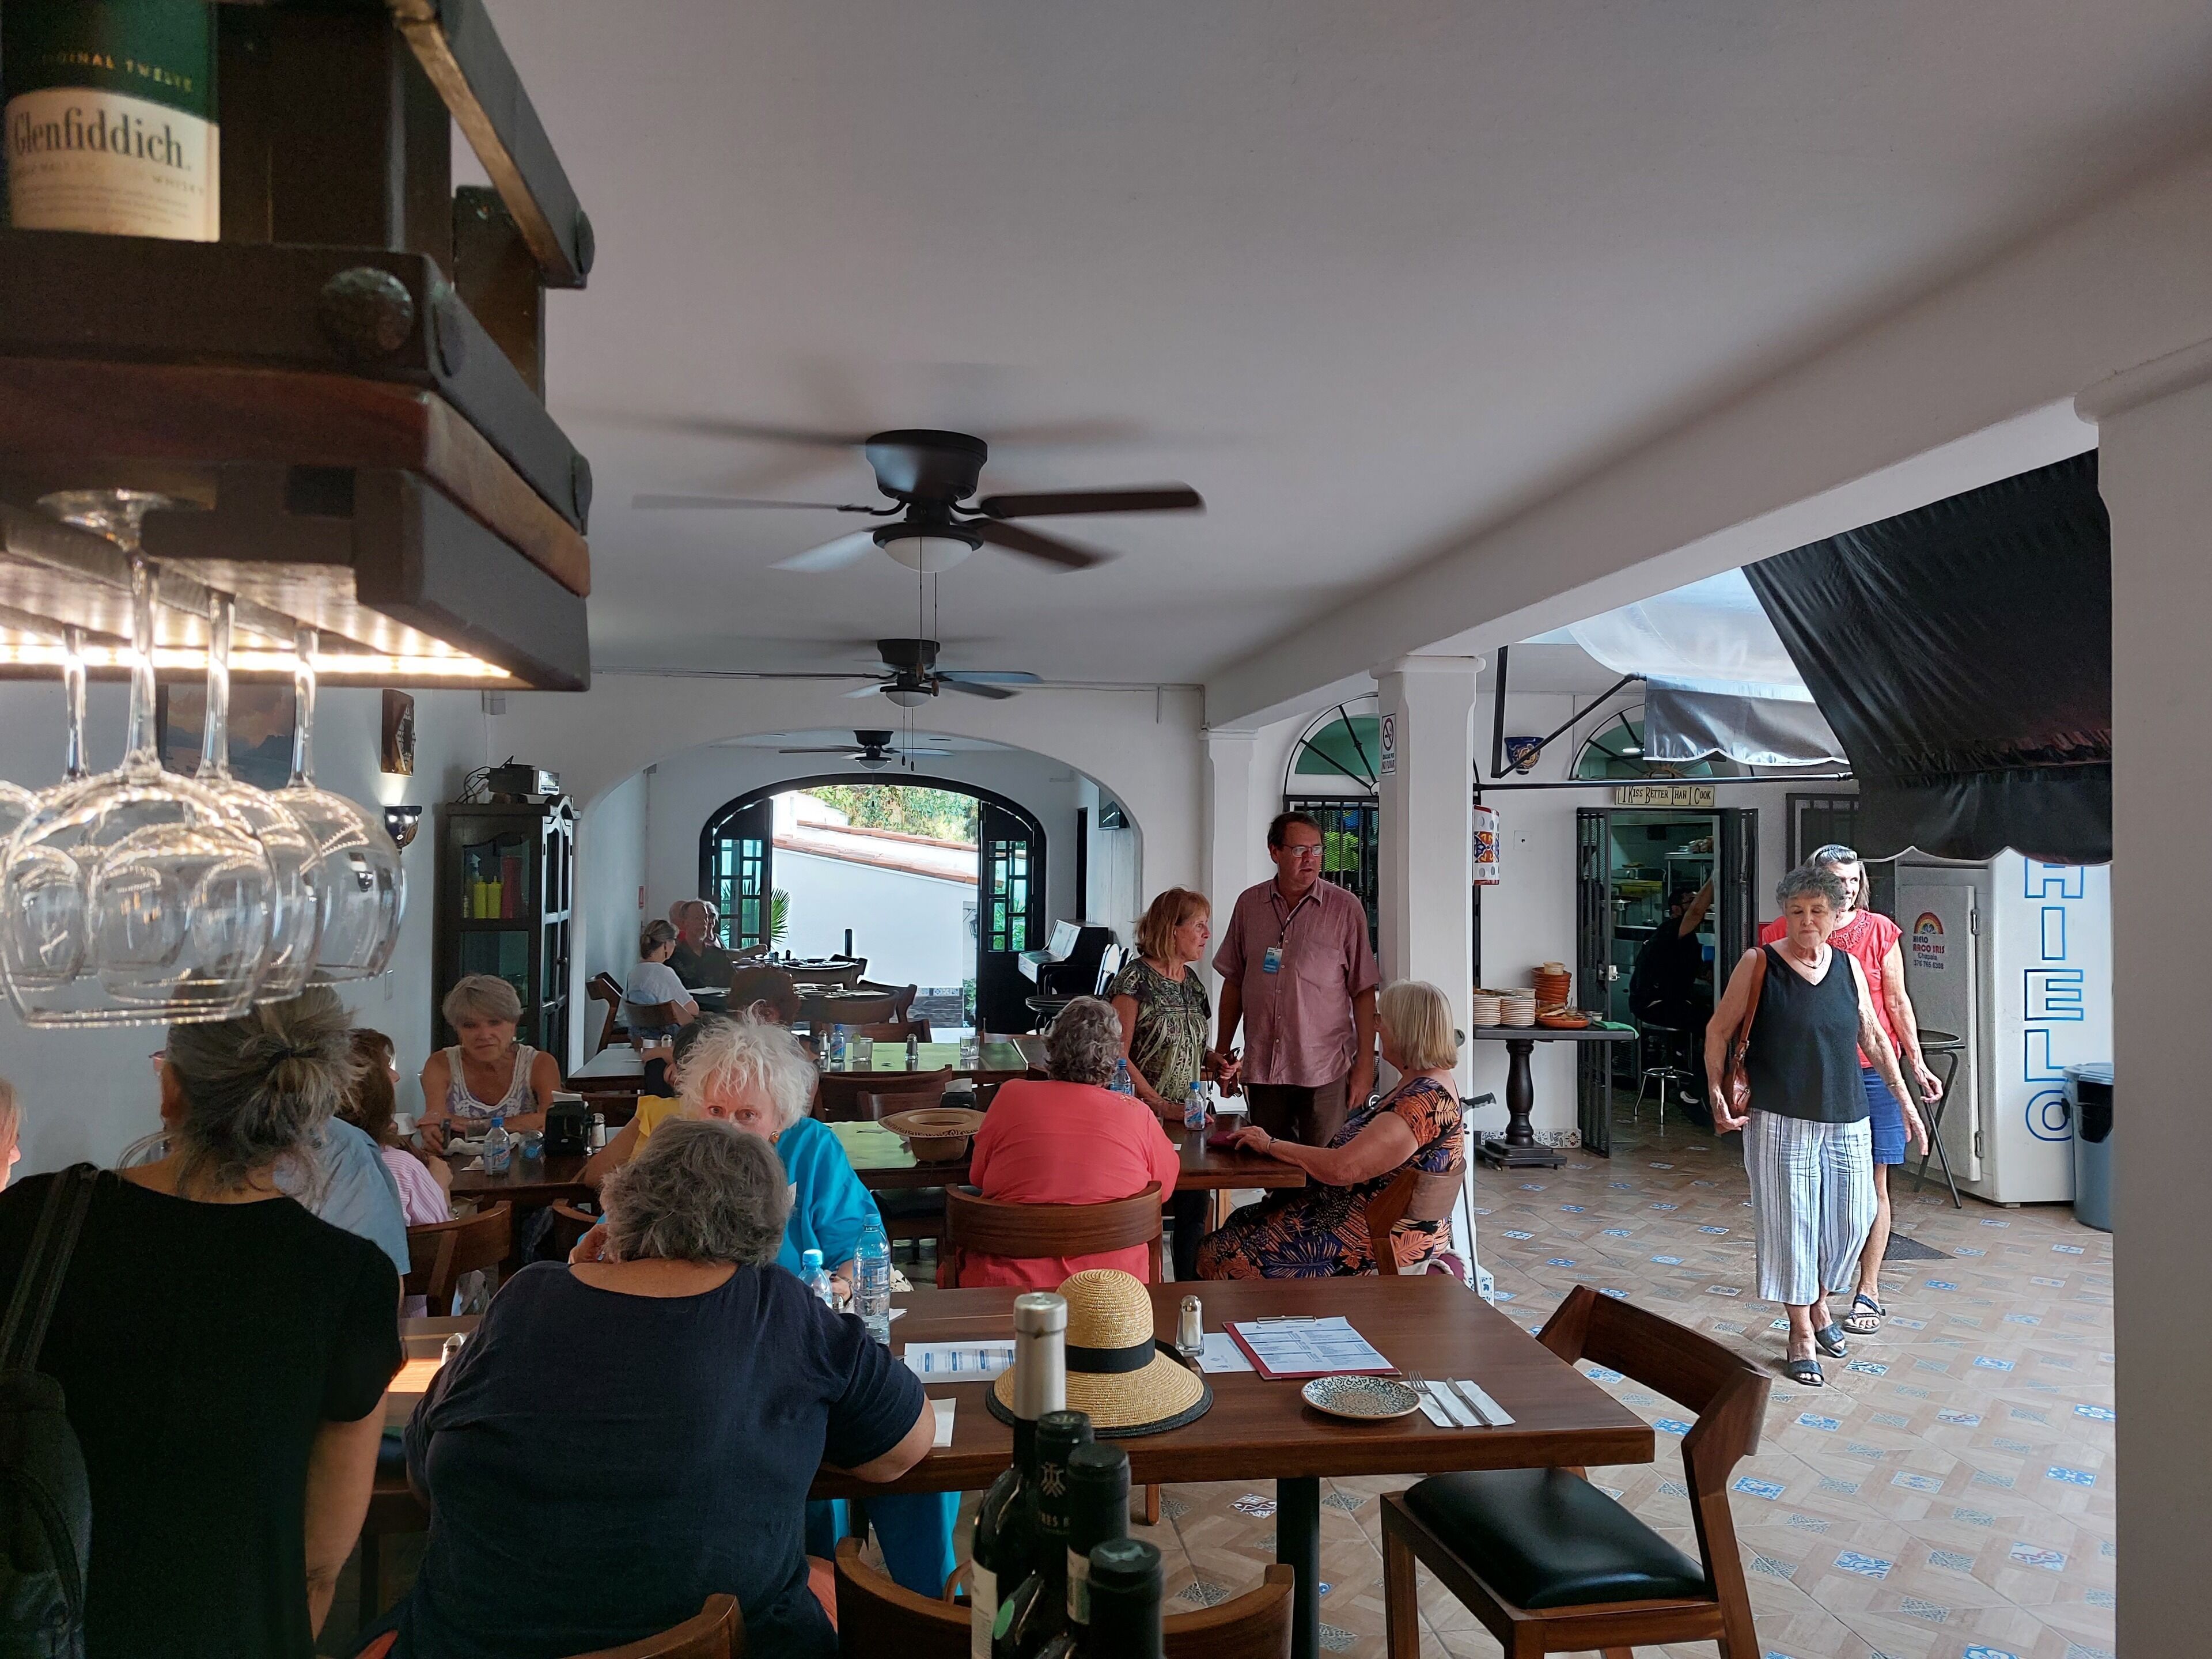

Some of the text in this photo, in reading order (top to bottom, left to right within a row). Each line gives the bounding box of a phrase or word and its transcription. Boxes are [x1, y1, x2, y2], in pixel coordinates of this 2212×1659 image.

[14, 107, 183, 169] Glenfiddich
[1622, 786, 1711, 805] I KISS BETTER THAN I COOK
[1913, 944, 1944, 953] ARCO IRIS
[2024, 857, 2084, 1142] HIELO
